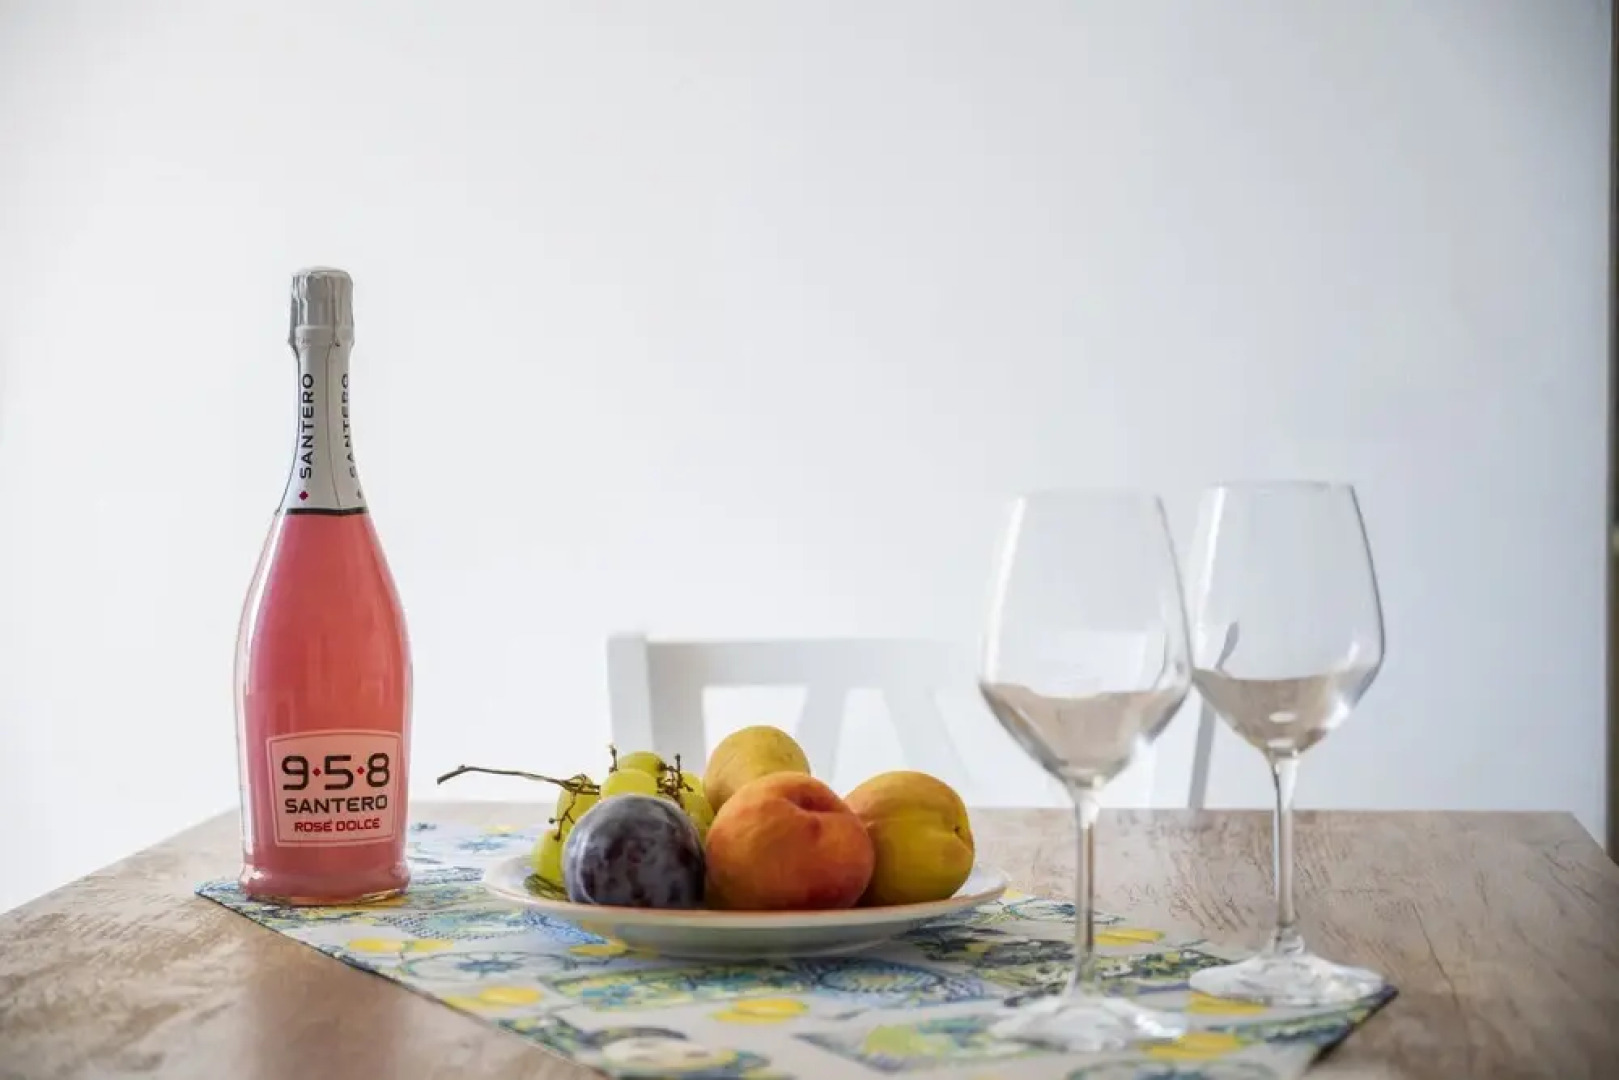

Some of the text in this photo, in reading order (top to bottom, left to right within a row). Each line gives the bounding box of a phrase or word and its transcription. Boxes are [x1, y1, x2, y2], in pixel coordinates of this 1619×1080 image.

[300, 374, 314, 479] SANTERO
[285, 795, 387, 813] SANTERO
[336, 818, 380, 831] DOLCE
